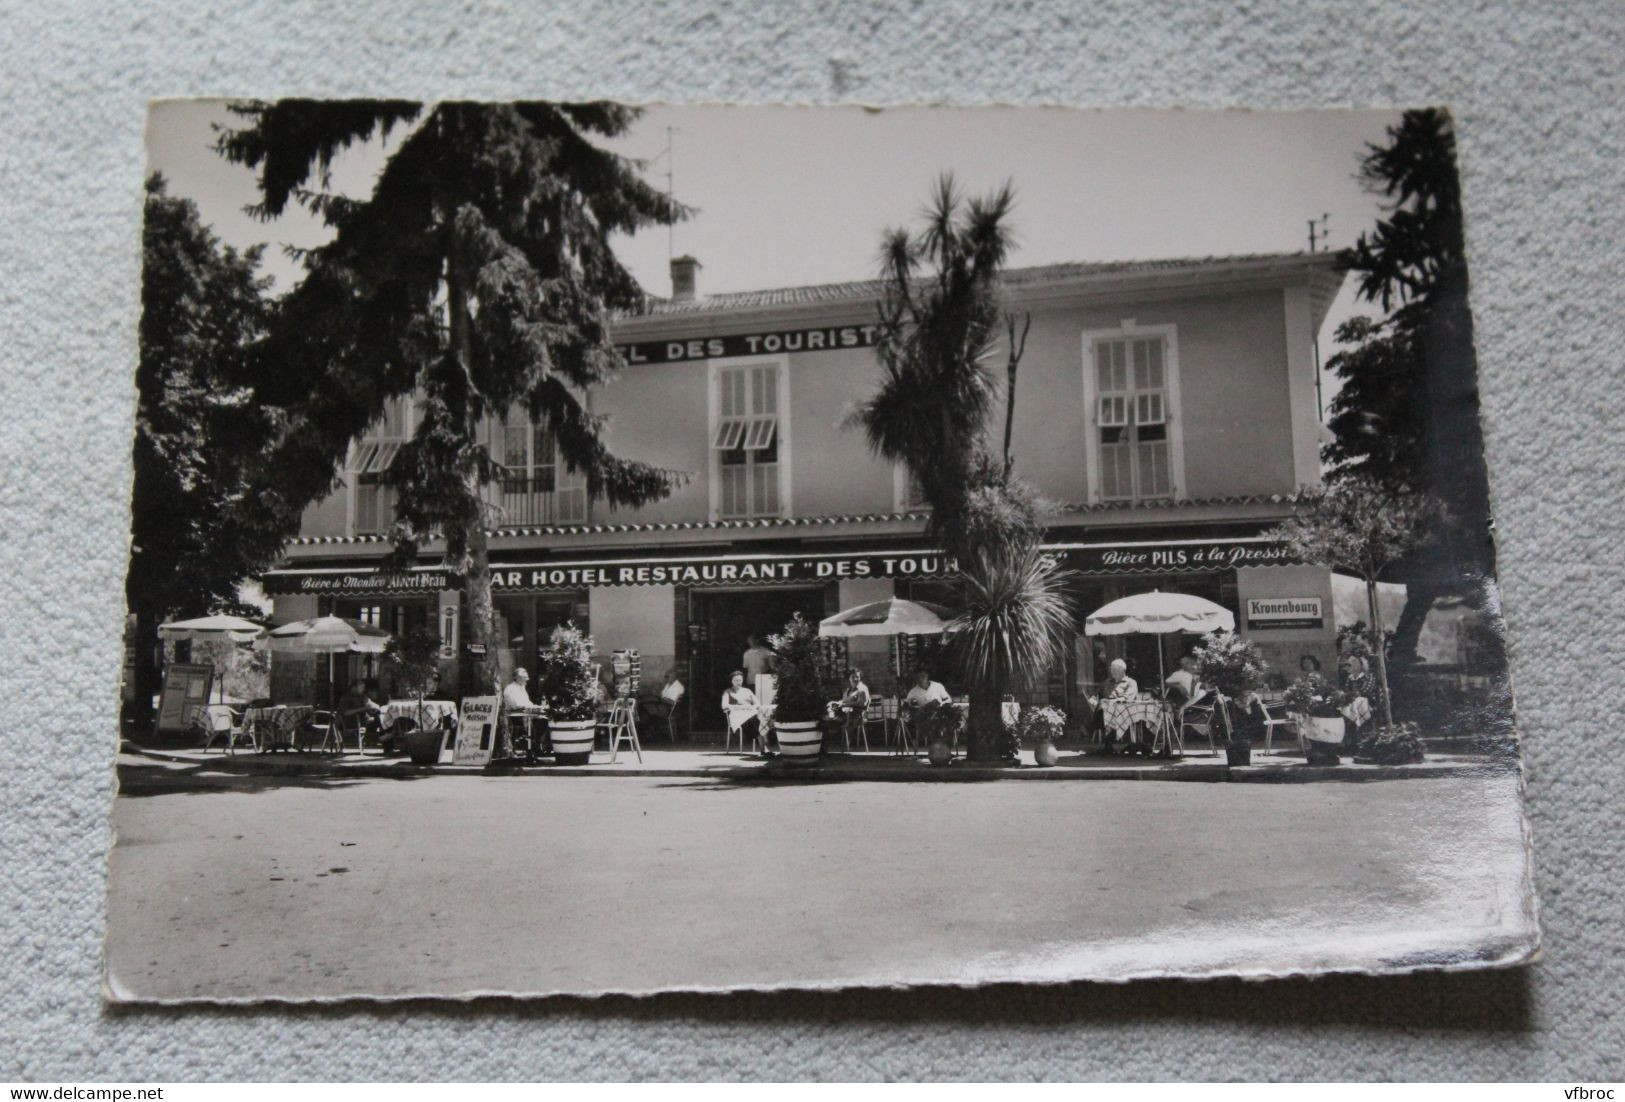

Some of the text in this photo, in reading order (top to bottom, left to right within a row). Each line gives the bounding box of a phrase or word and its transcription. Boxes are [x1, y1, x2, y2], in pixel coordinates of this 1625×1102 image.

[667, 339, 725, 359] DES
[1152, 550, 1187, 565] PILS
[1208, 546, 1224, 560] la
[1228, 546, 1298, 565] Pressi
[531, 568, 612, 585] HOTEL
[619, 563, 794, 582] RESTAURANT
[803, 560, 871, 577] "DES
[1251, 601, 1318, 616] Kronenbourg
